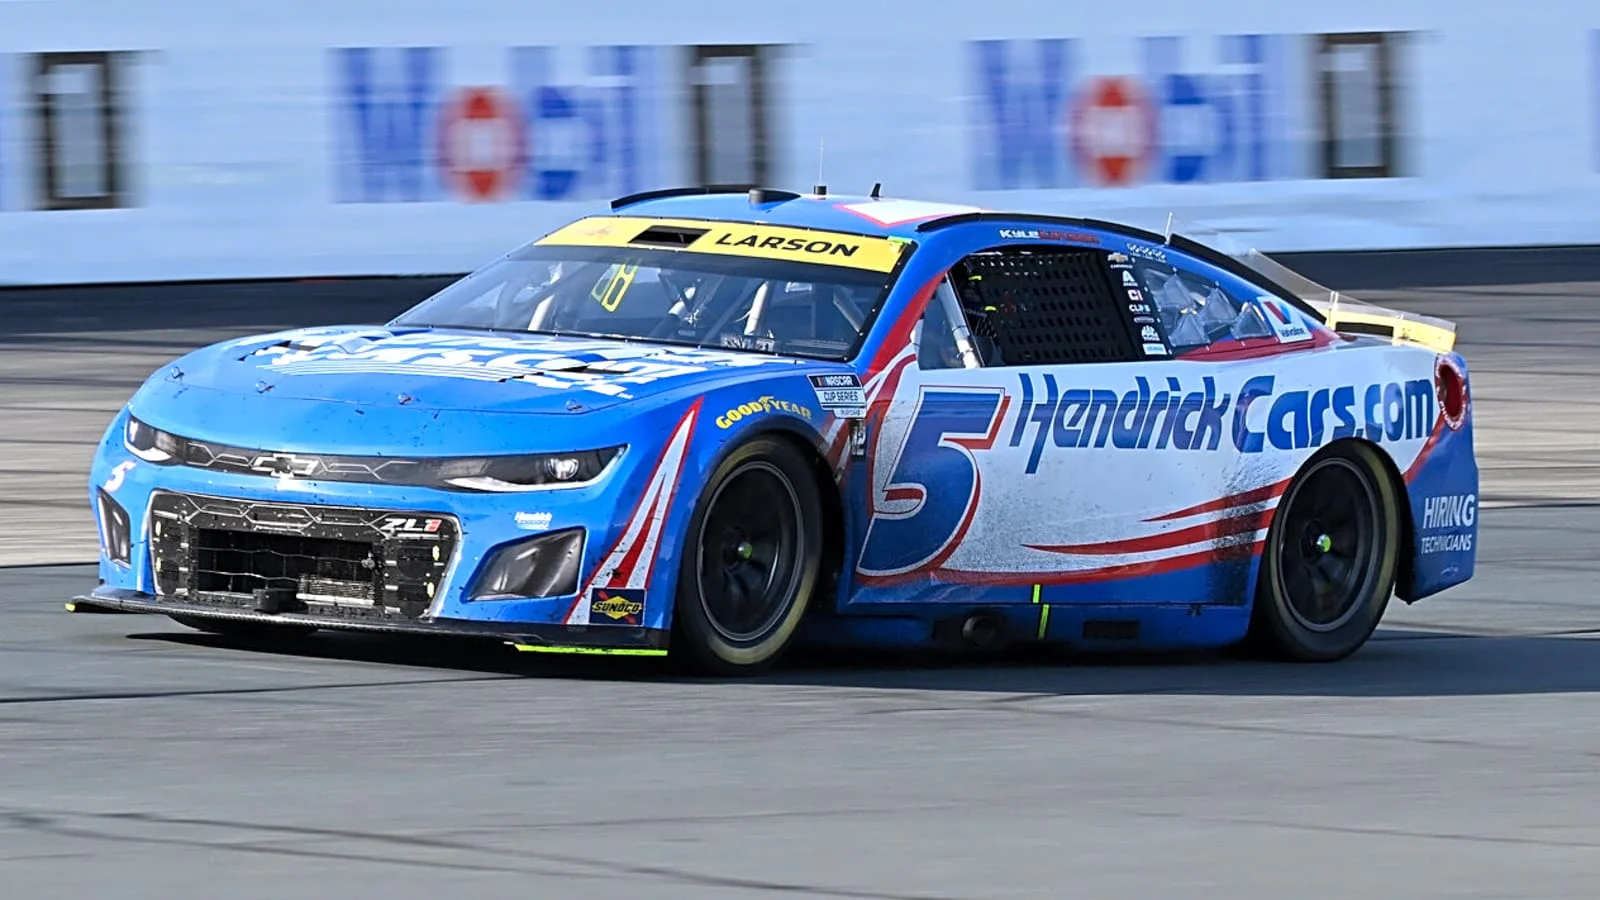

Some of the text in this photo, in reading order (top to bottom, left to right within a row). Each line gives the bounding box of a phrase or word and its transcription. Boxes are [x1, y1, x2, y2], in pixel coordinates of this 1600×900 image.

[715, 233, 859, 257] LARSON
[825, 376, 853, 386] NASCAR
[823, 391, 859, 401] CUP SERIES
[716, 398, 812, 429] GOODYEAR
[103, 460, 137, 492] 5
[858, 386, 1006, 576] 5
[1423, 494, 1475, 529] HIRING
[1421, 534, 1472, 554] TECHNICIANS
[594, 602, 641, 613] SUNOCO
